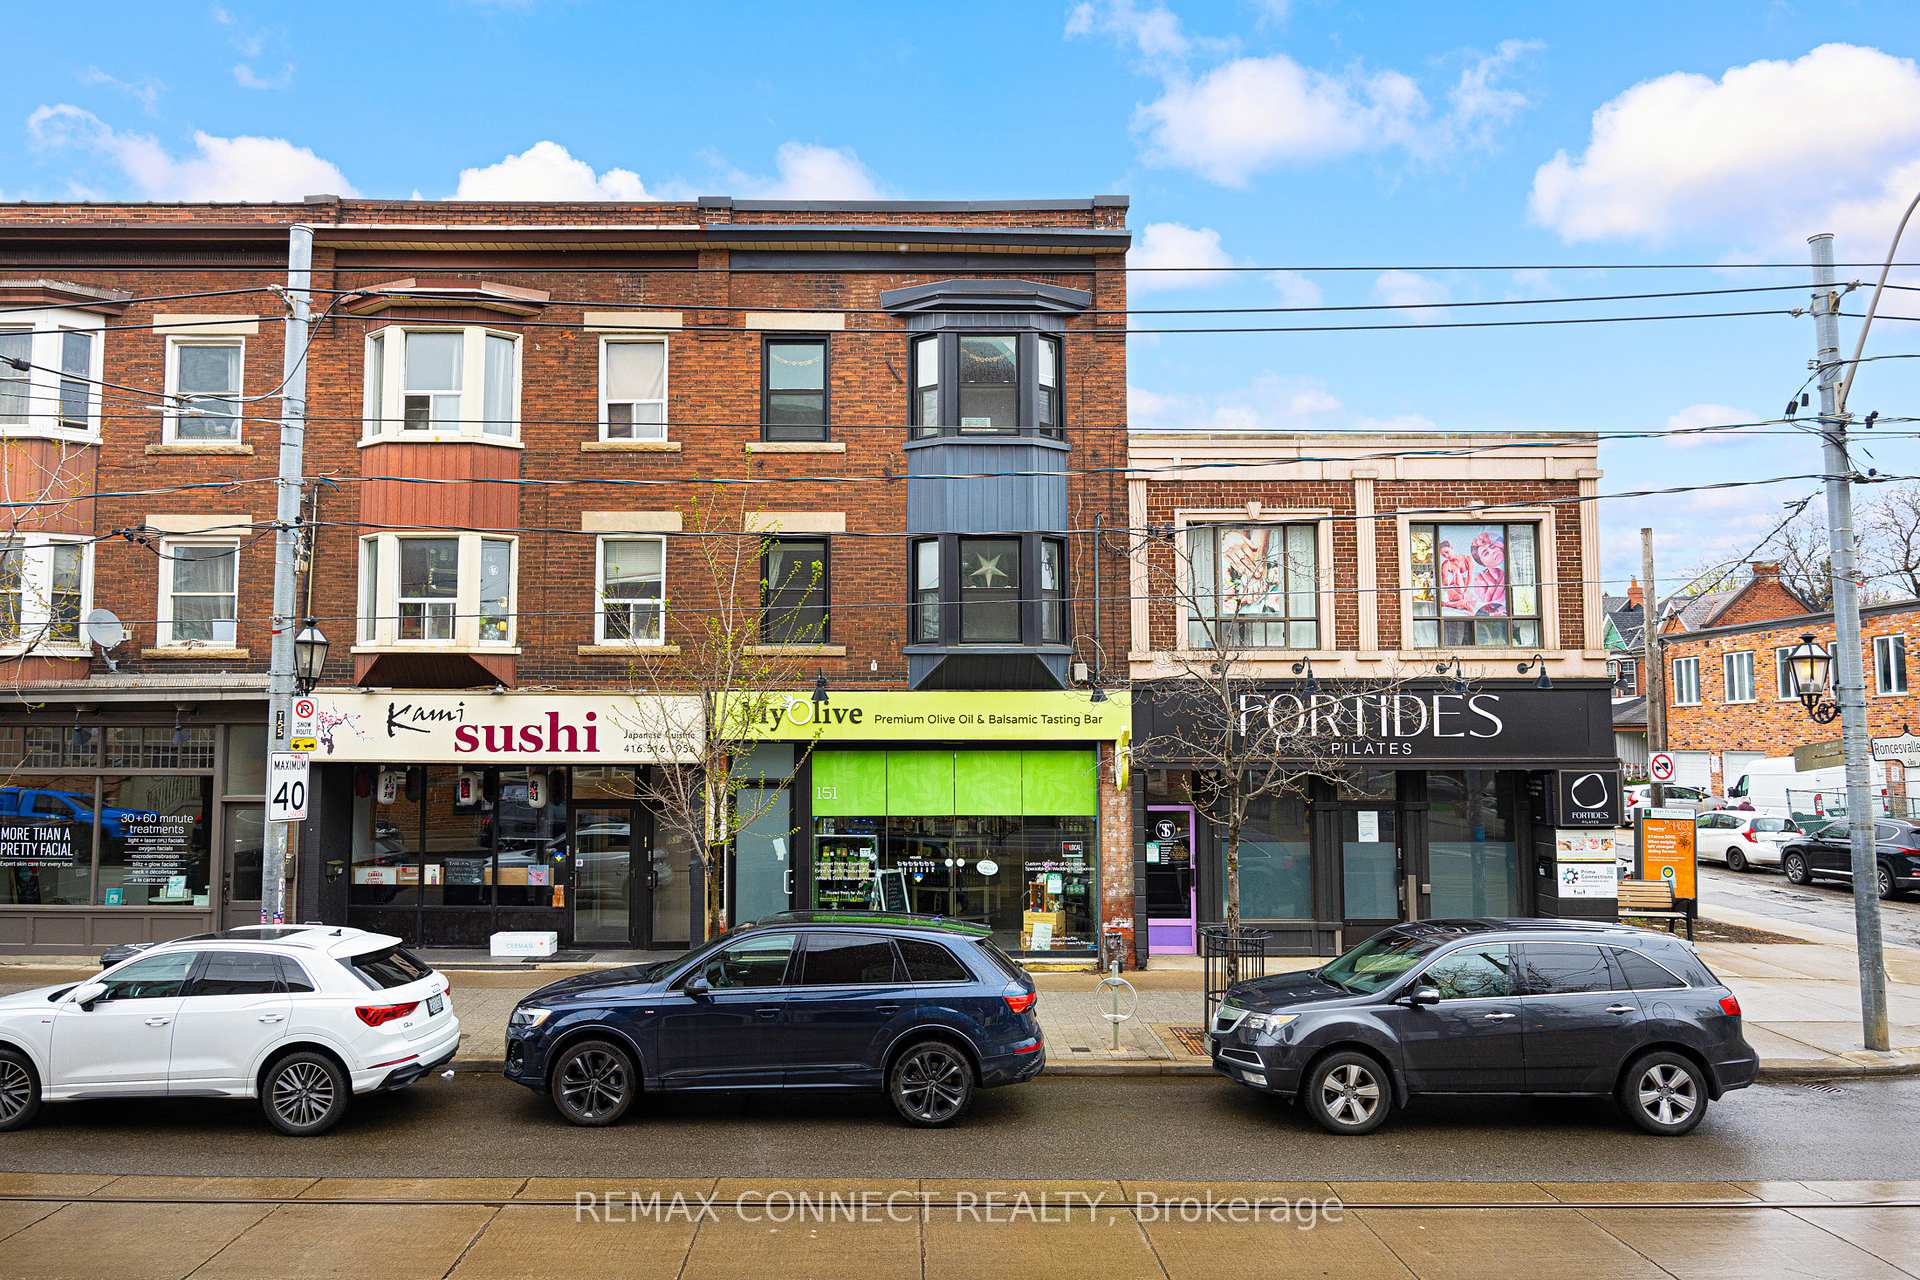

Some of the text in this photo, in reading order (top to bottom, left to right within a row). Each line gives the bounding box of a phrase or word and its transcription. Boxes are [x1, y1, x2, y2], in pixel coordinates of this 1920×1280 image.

[387, 701, 465, 738] Kami
[874, 714, 1103, 726] Premium Olive Oil & Balsamic Tasting Bar
[1239, 693, 1503, 738] FORTIDES
[454, 711, 600, 753] sushi
[1331, 743, 1412, 755] PILATES
[274, 760, 306, 770] MAXIMUM
[273, 780, 305, 811] 40
[816, 786, 838, 800] 151
[160, 814, 194, 824] minute
[1571, 811, 1609, 819] FORTIDES
[1, 827, 71, 841] MORE THAN A
[129, 825, 185, 834] treatments
[0, 842, 73, 856] PRETTY FACIAL
